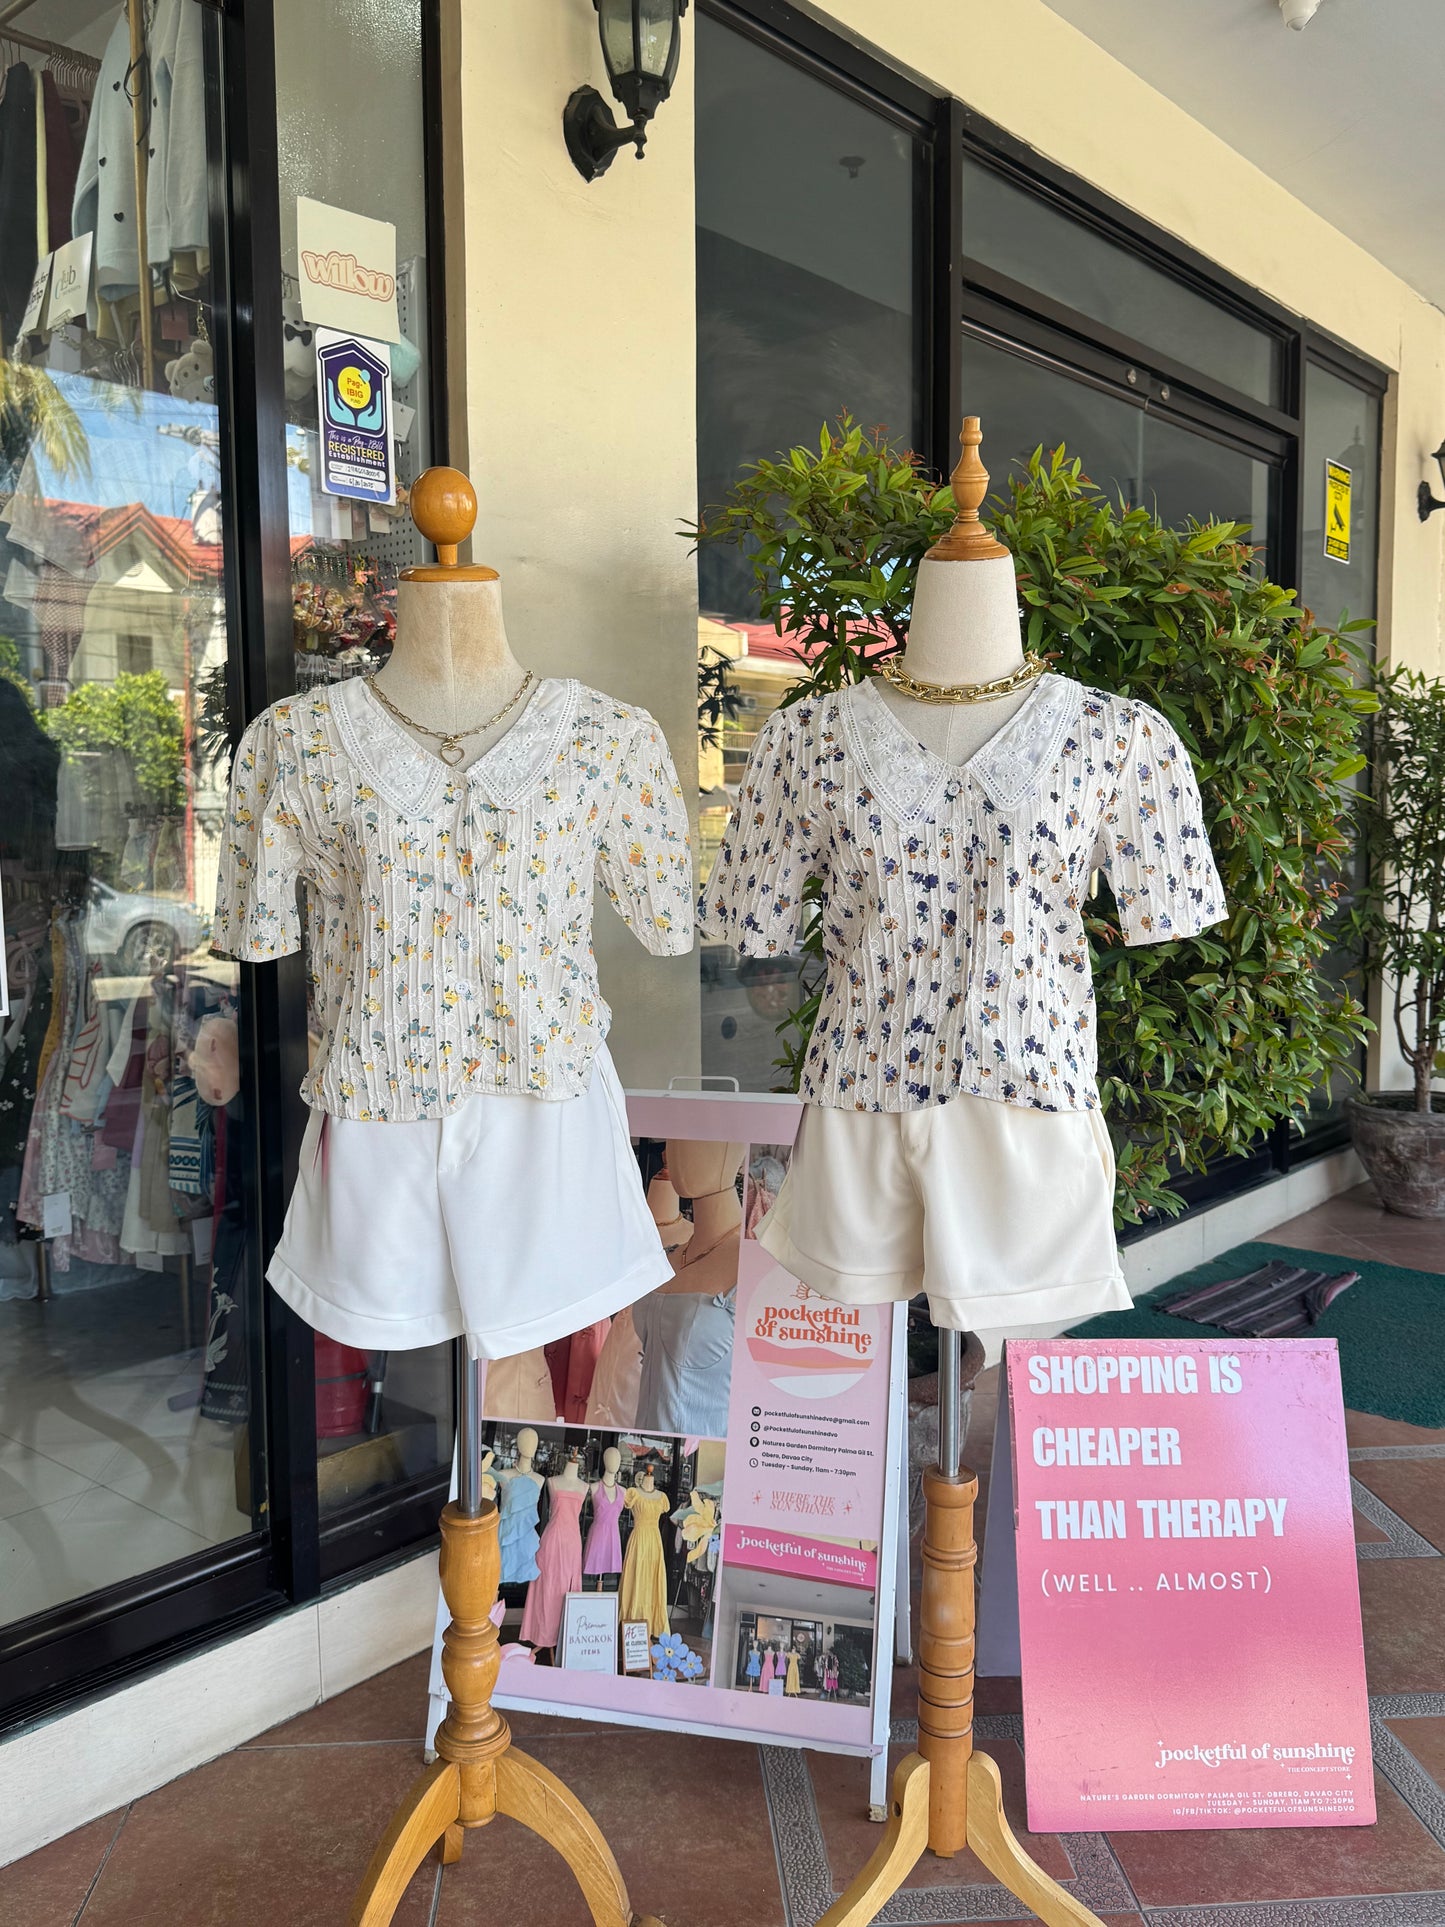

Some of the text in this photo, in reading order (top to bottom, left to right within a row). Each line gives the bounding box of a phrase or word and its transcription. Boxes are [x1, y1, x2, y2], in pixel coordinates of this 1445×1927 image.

[346, 377, 363, 389] Pag-
[346, 388, 364, 399] IBIG
[328, 430, 339, 441] This
[328, 440, 385, 461] REGISTERED
[328, 450, 386, 468] Establishment
[761, 1304, 860, 1330] pocketful
[755, 1318, 872, 1354] of sunshine
[1028, 1355, 1243, 1394] SHOPPING IS
[764, 1410, 870, 1426] pocketfulofsunshinedvo@gmail.com
[762, 1440, 785, 1448] Natures
[786, 1442, 807, 1450] Garden
[808, 1444, 837, 1454] Dormitory
[838, 1447, 857, 1455] Palma
[1032, 1427, 1182, 1466] CHEAPER
[801, 1455, 813, 1463] City
[761, 1461, 786, 1470] Tuesday
[790, 1464, 815, 1473] Sunday,
[834, 1468, 857, 1477] 7:30pm
[771, 1490, 836, 1507] WHERE THE
[769, 1500, 836, 1516] SUN SHINES
[1035, 1497, 1288, 1540] THAN THERAPY
[737, 1535, 801, 1557] pocketful
[804, 1547, 817, 1558] of
[817, 1551, 867, 1573] sunshine
[1041, 1569, 1117, 1597] (WELL
[1156, 1566, 1272, 1594] ALMOST)
[569, 1634, 613, 1645] BANGKOK
[1155, 1743, 1356, 1768] pocketful of sunshine
[1080, 1793, 1119, 1801] NATURE'S
[1121, 1793, 1155, 1801] GARDEN
[1157, 1792, 1205, 1800] DORMITORY
[1207, 1791, 1235, 1799] PALMA
[1237, 1791, 1250, 1799] GIL
[1252, 1791, 1265, 1799] ST.
[1335, 1789, 1354, 1797] CITY
[1207, 1799, 1243, 1807] TUESDAY
[1234, 1805, 1355, 1816] @POCKETFULOFSUNSHINEDVO
